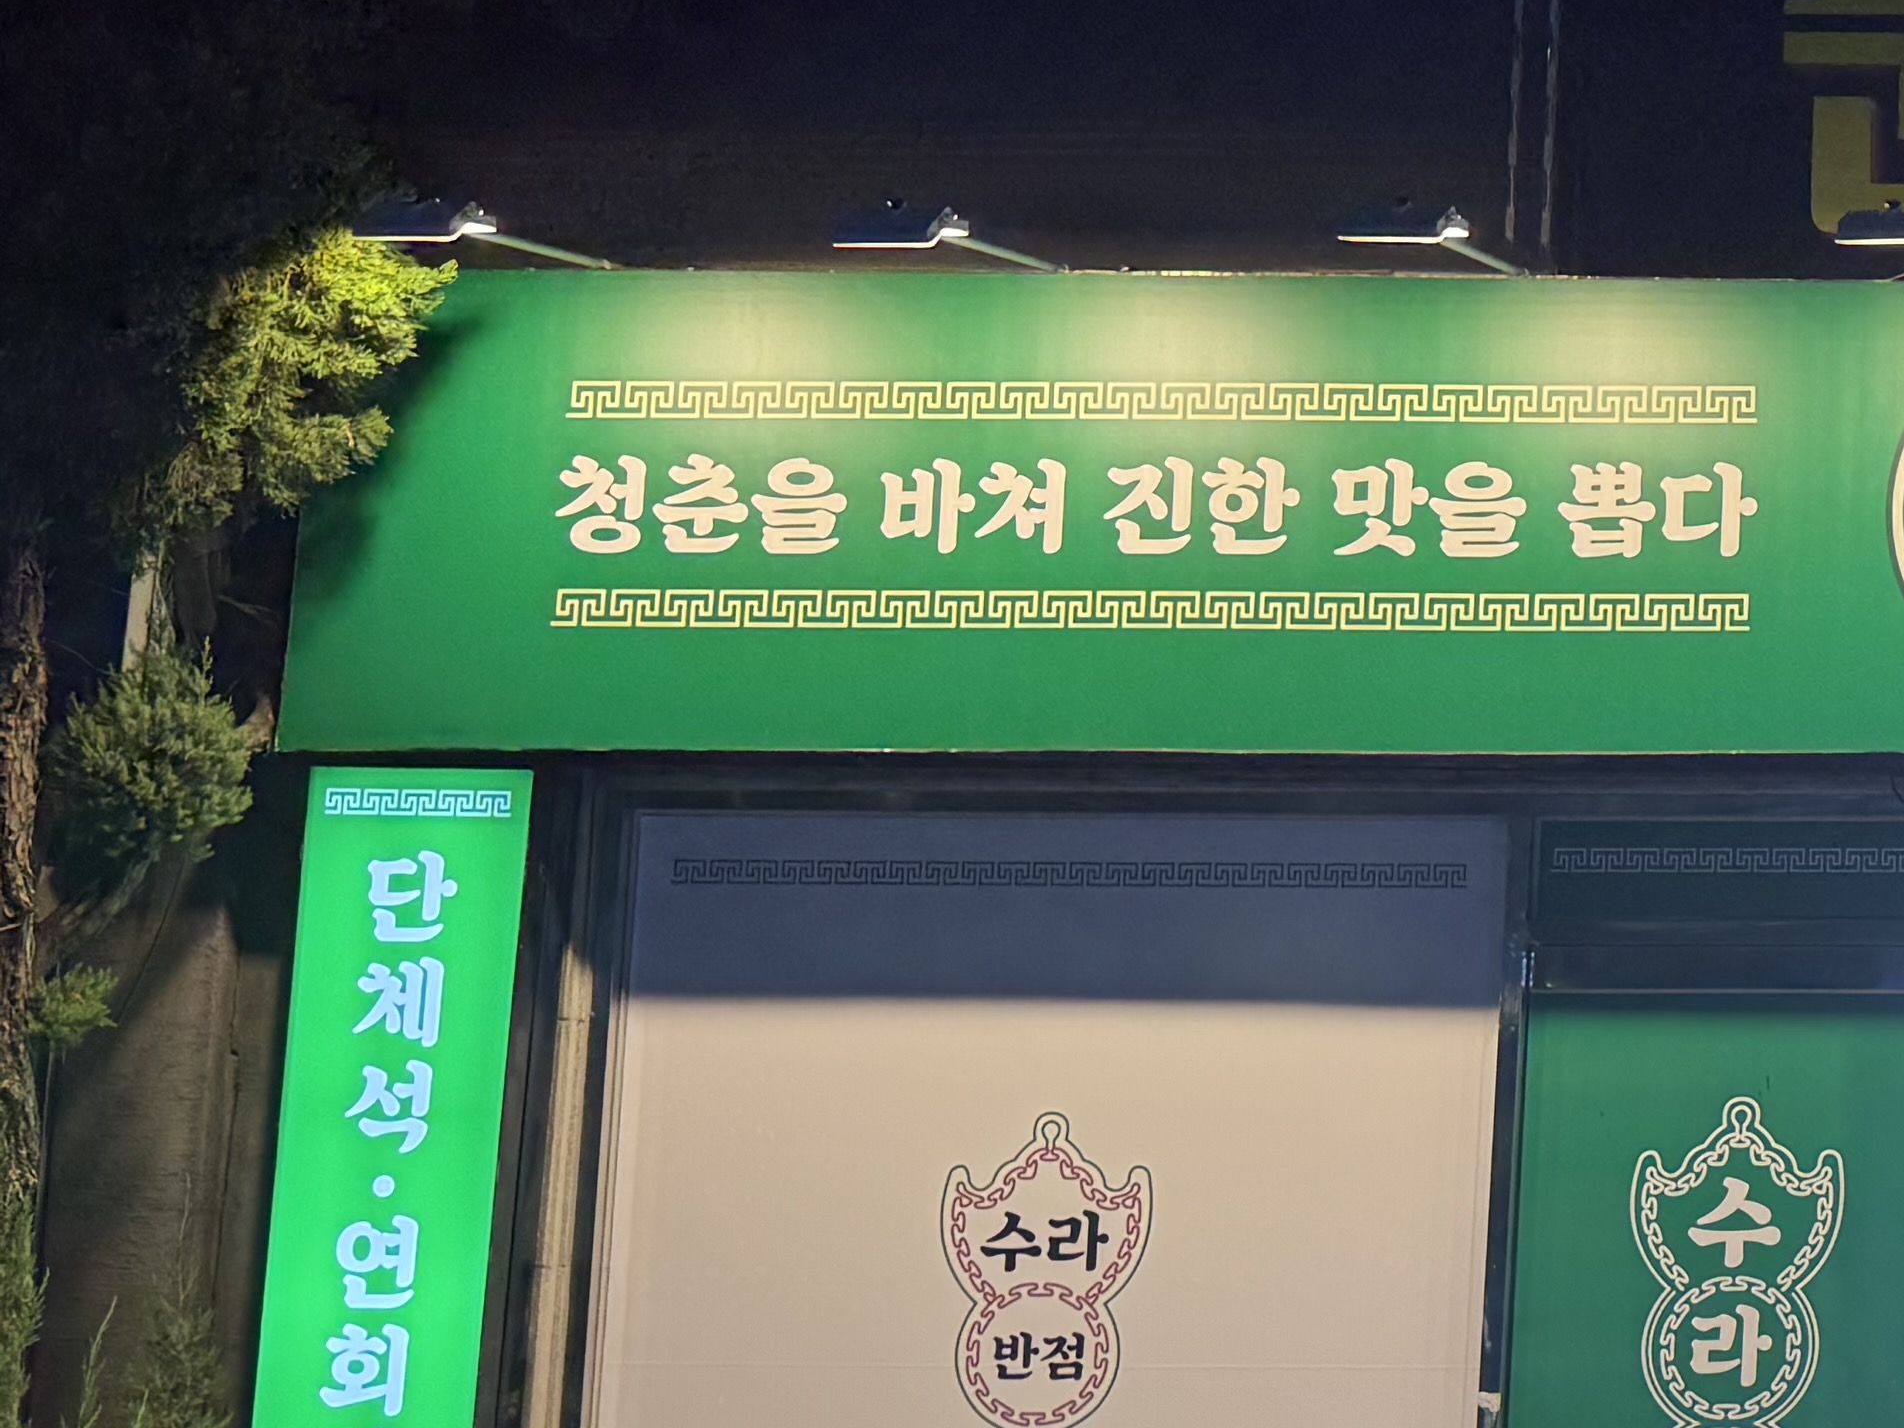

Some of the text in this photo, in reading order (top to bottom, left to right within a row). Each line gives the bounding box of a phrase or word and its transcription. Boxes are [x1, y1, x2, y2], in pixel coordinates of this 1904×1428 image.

[555, 453, 1760, 560] 청춘을 바쳐 진한 맛을 뽑다
[979, 1209, 1110, 1272] 수라
[992, 1331, 1086, 1382] 반점
